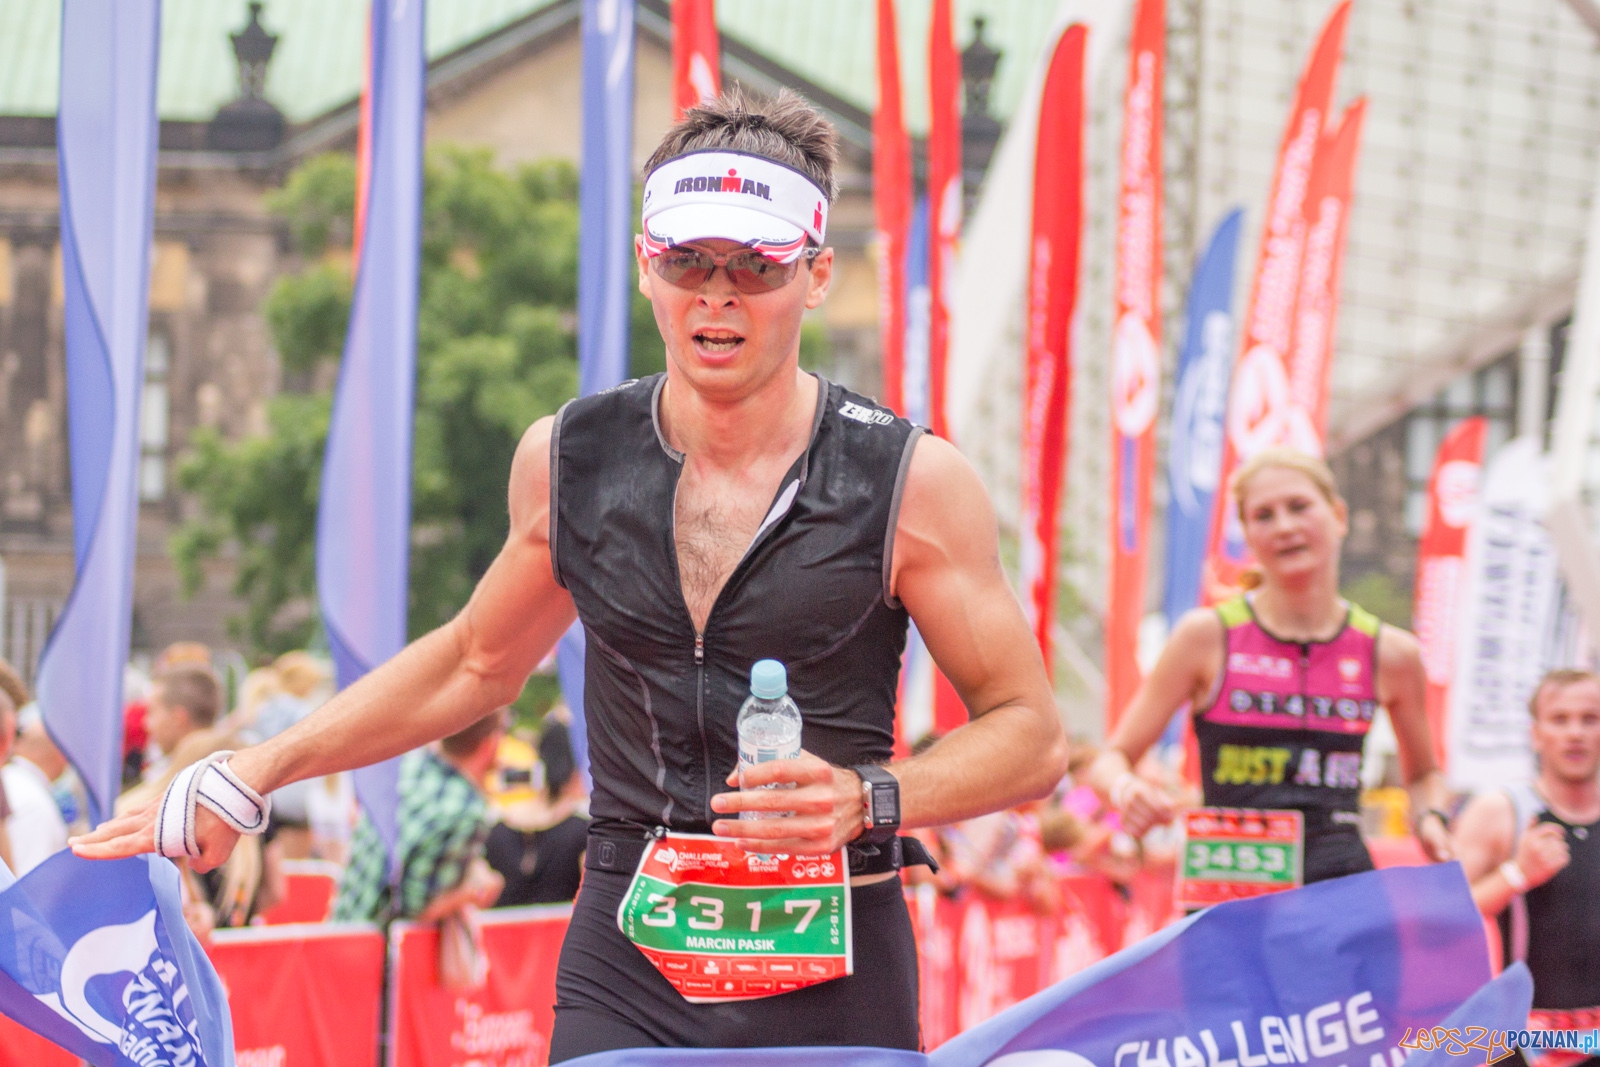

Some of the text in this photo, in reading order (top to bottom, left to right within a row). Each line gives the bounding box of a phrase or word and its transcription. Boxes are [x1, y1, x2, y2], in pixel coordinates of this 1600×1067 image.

[641, 892, 822, 934] 3317
[686, 936, 775, 951] MARCIN PASIK
[1114, 990, 1385, 1067] CHALLENGE
